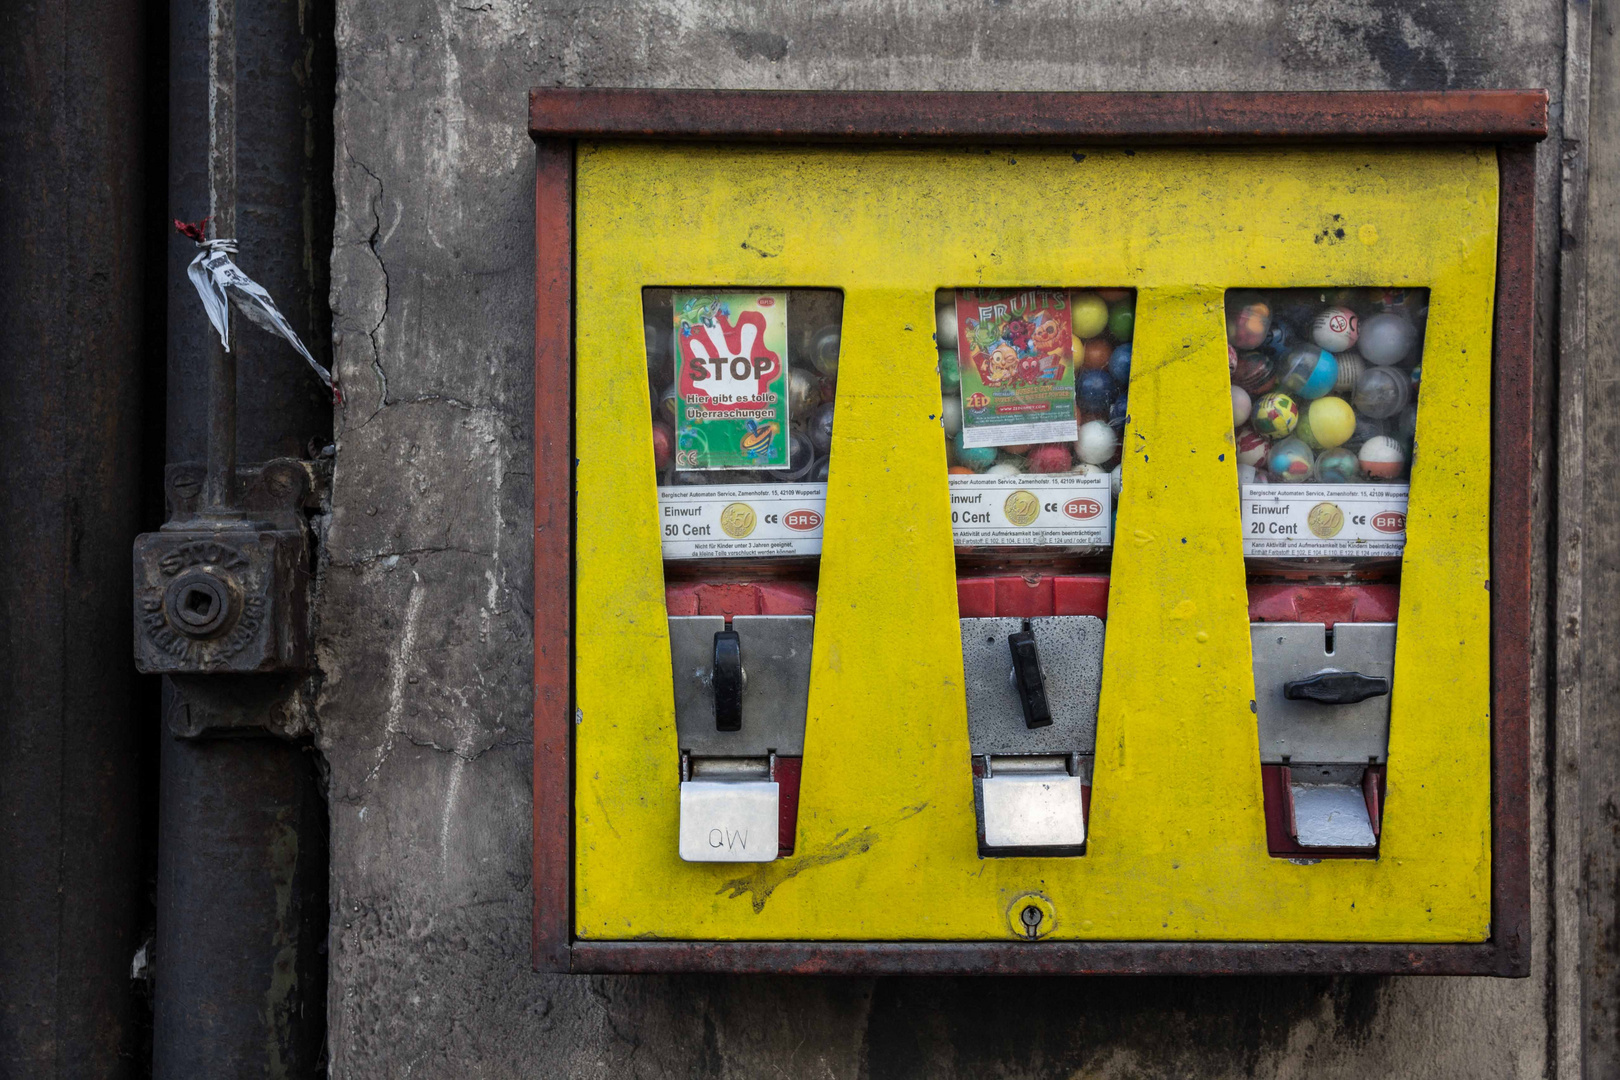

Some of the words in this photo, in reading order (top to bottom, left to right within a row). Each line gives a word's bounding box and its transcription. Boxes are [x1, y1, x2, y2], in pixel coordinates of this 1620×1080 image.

[978, 291, 1066, 328] FRUITS
[689, 357, 772, 382] STOP
[687, 394, 708, 403] Hier
[712, 394, 733, 406] gibt
[751, 394, 775, 402] tolle
[966, 396, 990, 408] ZED
[687, 408, 774, 419] Überraschungen
[950, 494, 982, 504] inwurf
[664, 506, 702, 516] Einwurf
[1068, 504, 1099, 513] BAS
[1252, 504, 1290, 514] Einwurf
[788, 515, 818, 525] BAS
[951, 511, 958, 523] 0
[962, 511, 991, 523] Cent
[665, 524, 678, 536] 50
[682, 524, 711, 536] Cent
[1251, 522, 1265, 534] 20
[1269, 522, 1297, 534] Cent
[709, 828, 748, 850] QW
